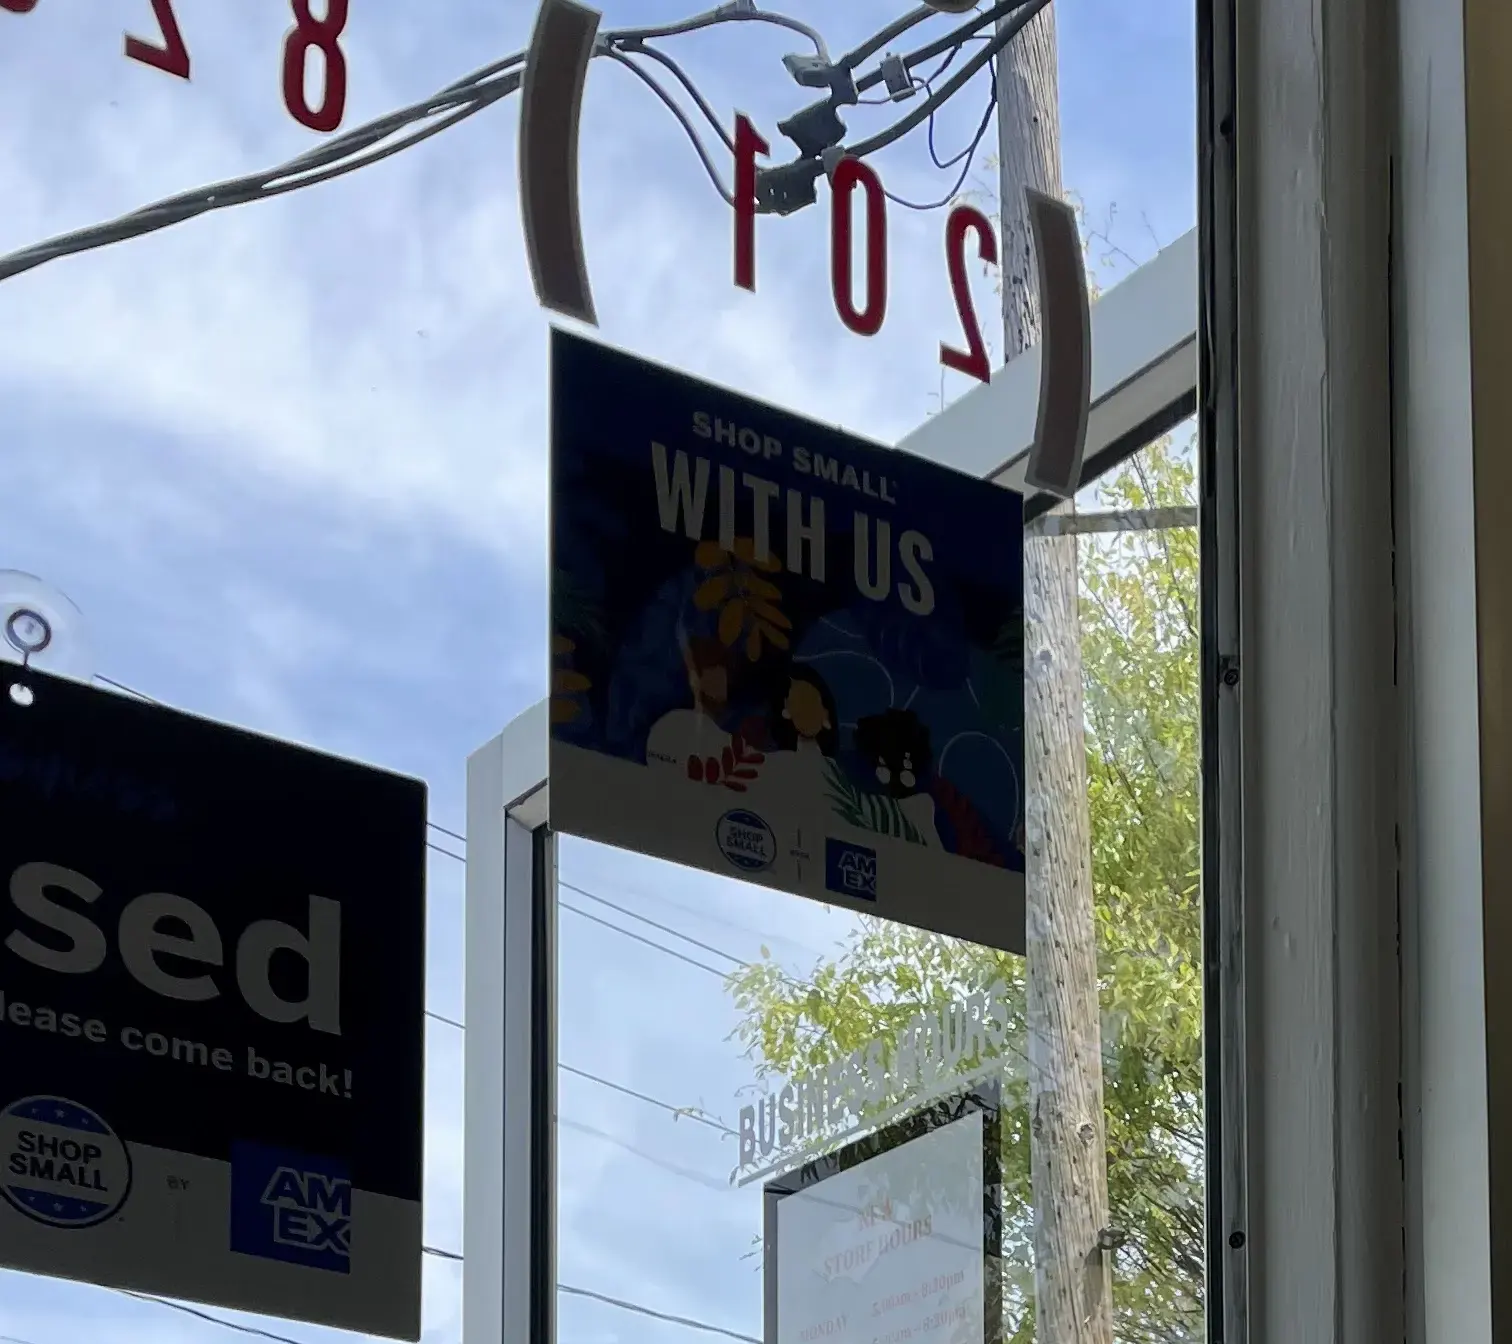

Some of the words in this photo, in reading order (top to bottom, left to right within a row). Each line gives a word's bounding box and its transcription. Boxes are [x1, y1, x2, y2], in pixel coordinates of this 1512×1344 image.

[692, 411, 782, 459] SHOP
[651, 439, 826, 583] WITH
[853, 510, 936, 617] US
[4, 860, 342, 1036] sed
[120, 1026, 233, 1070] come
[246, 1045, 353, 1100] back!
[738, 1034, 883, 1169] BUSINESS
[896, 984, 1008, 1085] HOURS
[9, 1152, 108, 1192] SMALL
[17, 1131, 101, 1164] SHOP
[261, 1166, 351, 1219] AM
[273, 1204, 351, 1258] EX
